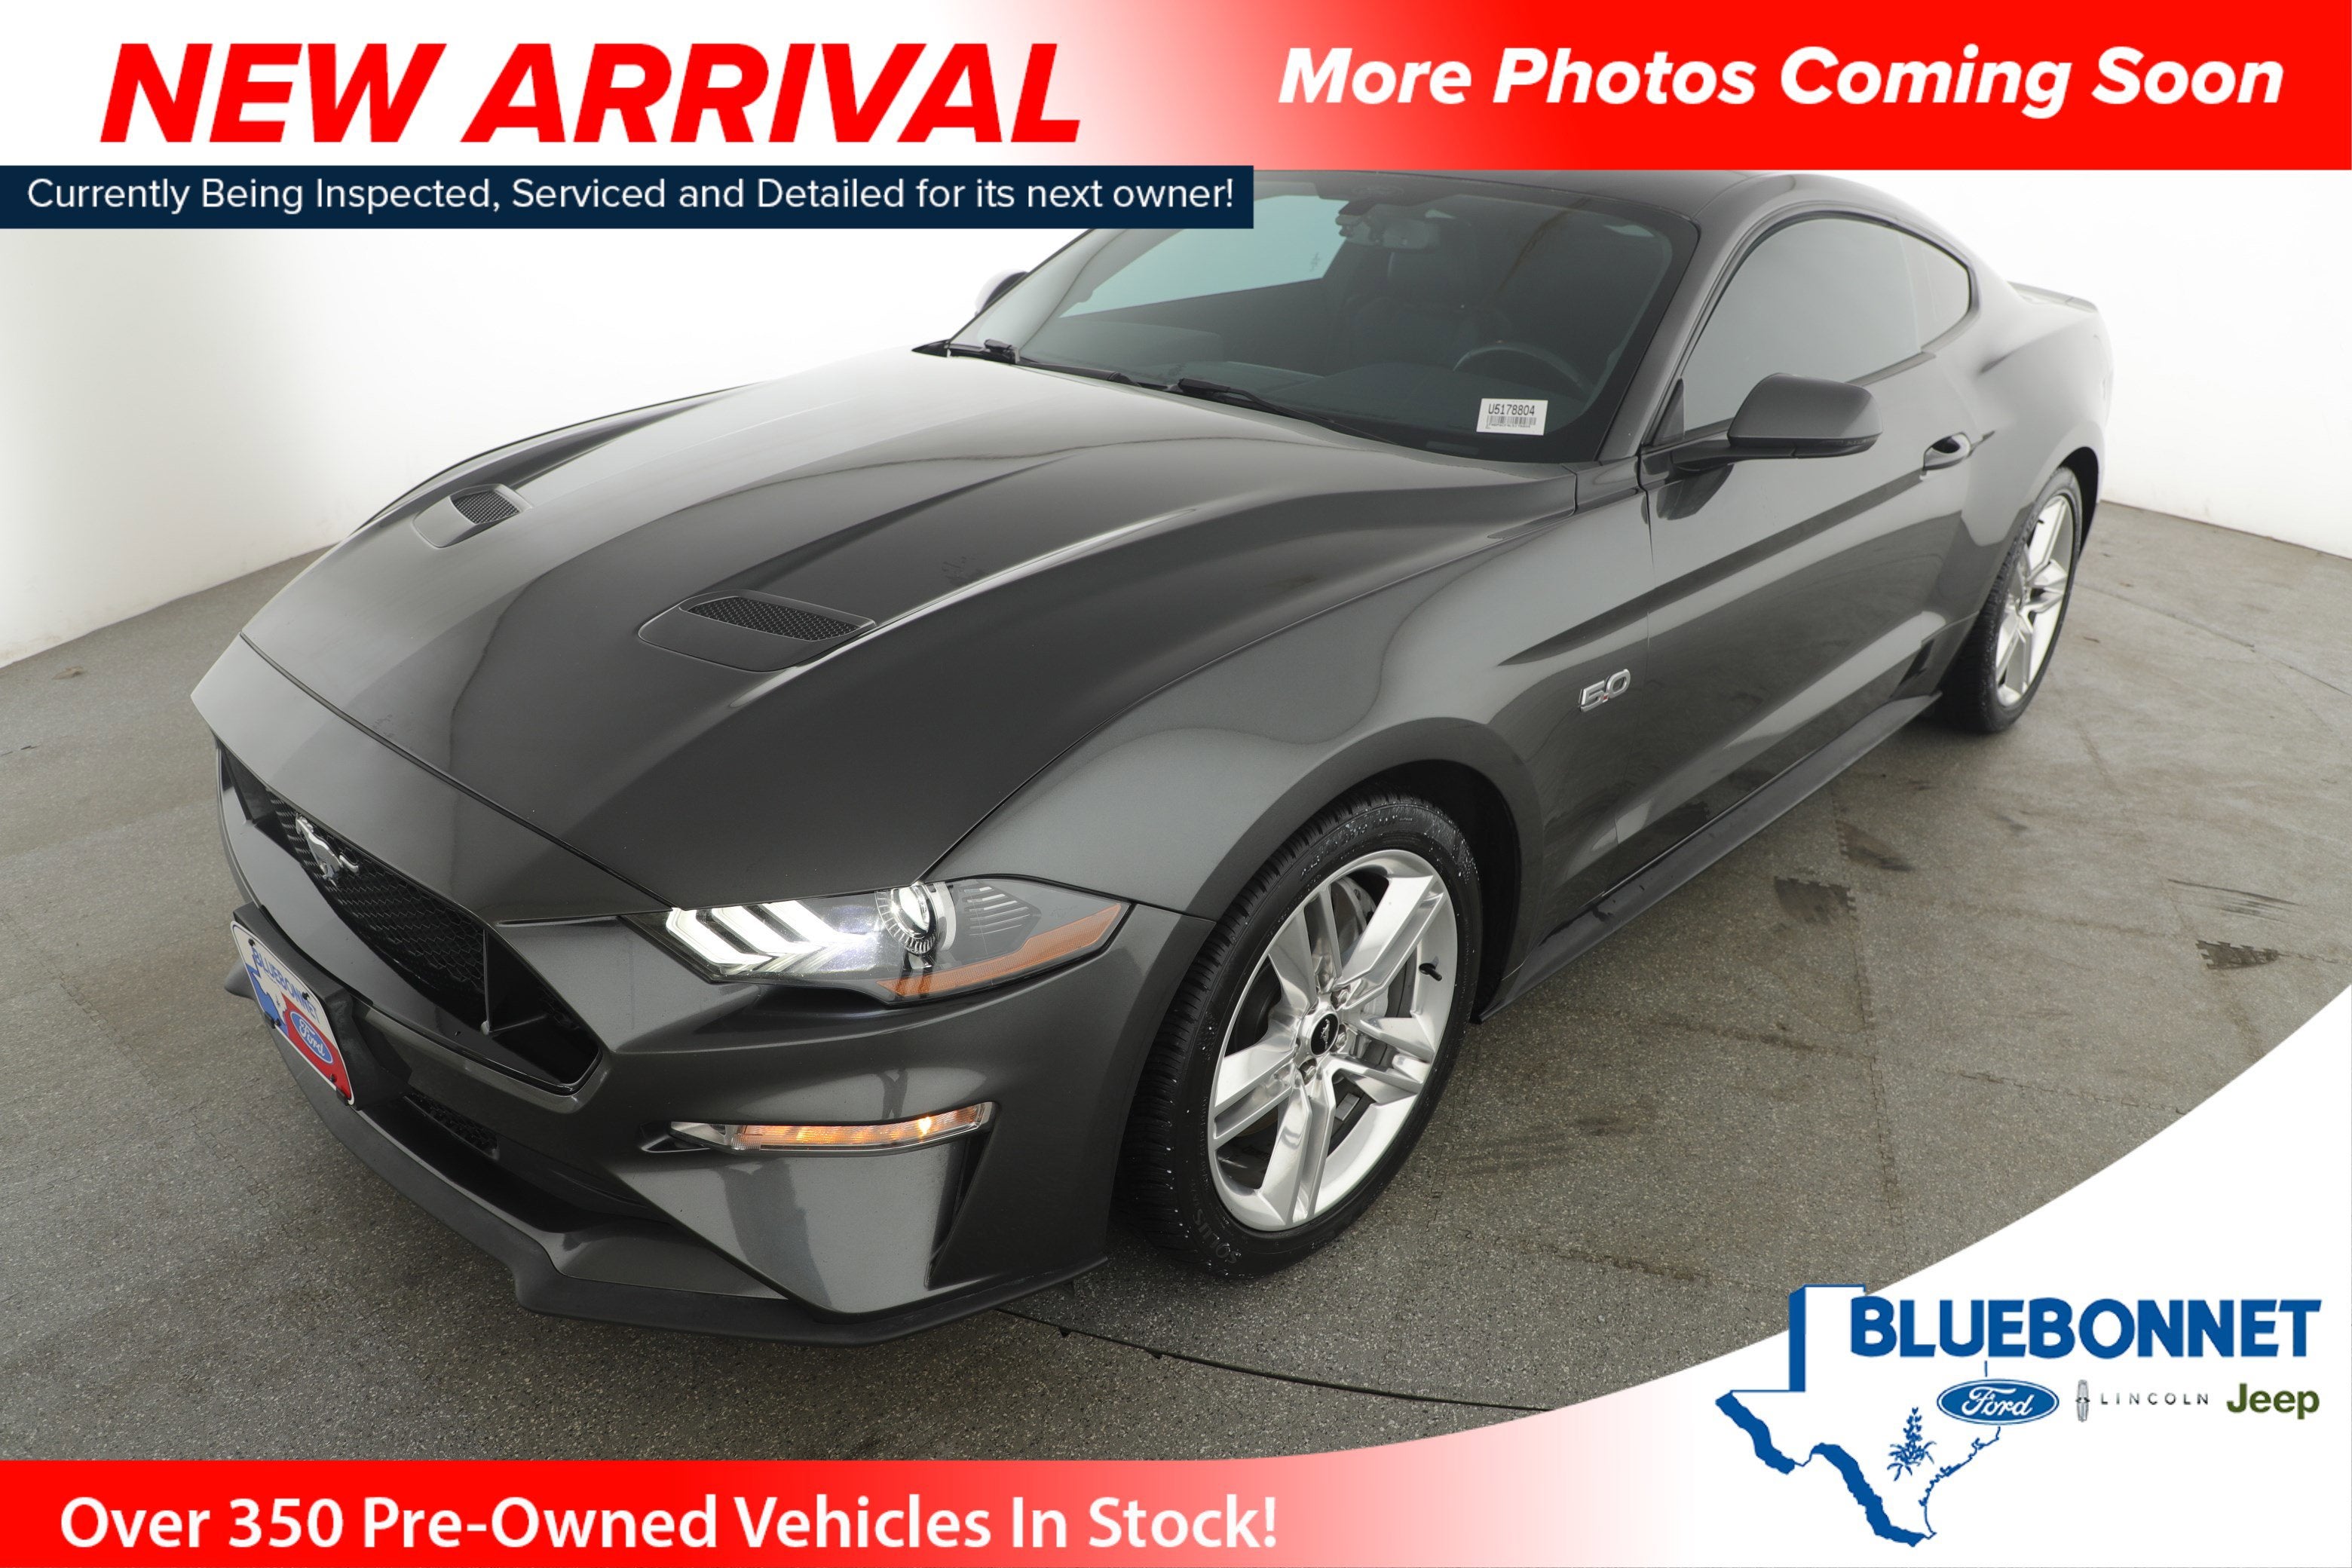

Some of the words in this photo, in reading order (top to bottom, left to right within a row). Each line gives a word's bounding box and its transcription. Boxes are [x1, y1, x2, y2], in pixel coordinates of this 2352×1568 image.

[1488, 403, 1536, 416] U5178804
[1580, 668, 1631, 712] 5.0
[252, 945, 320, 1023] BLUEBONNET
